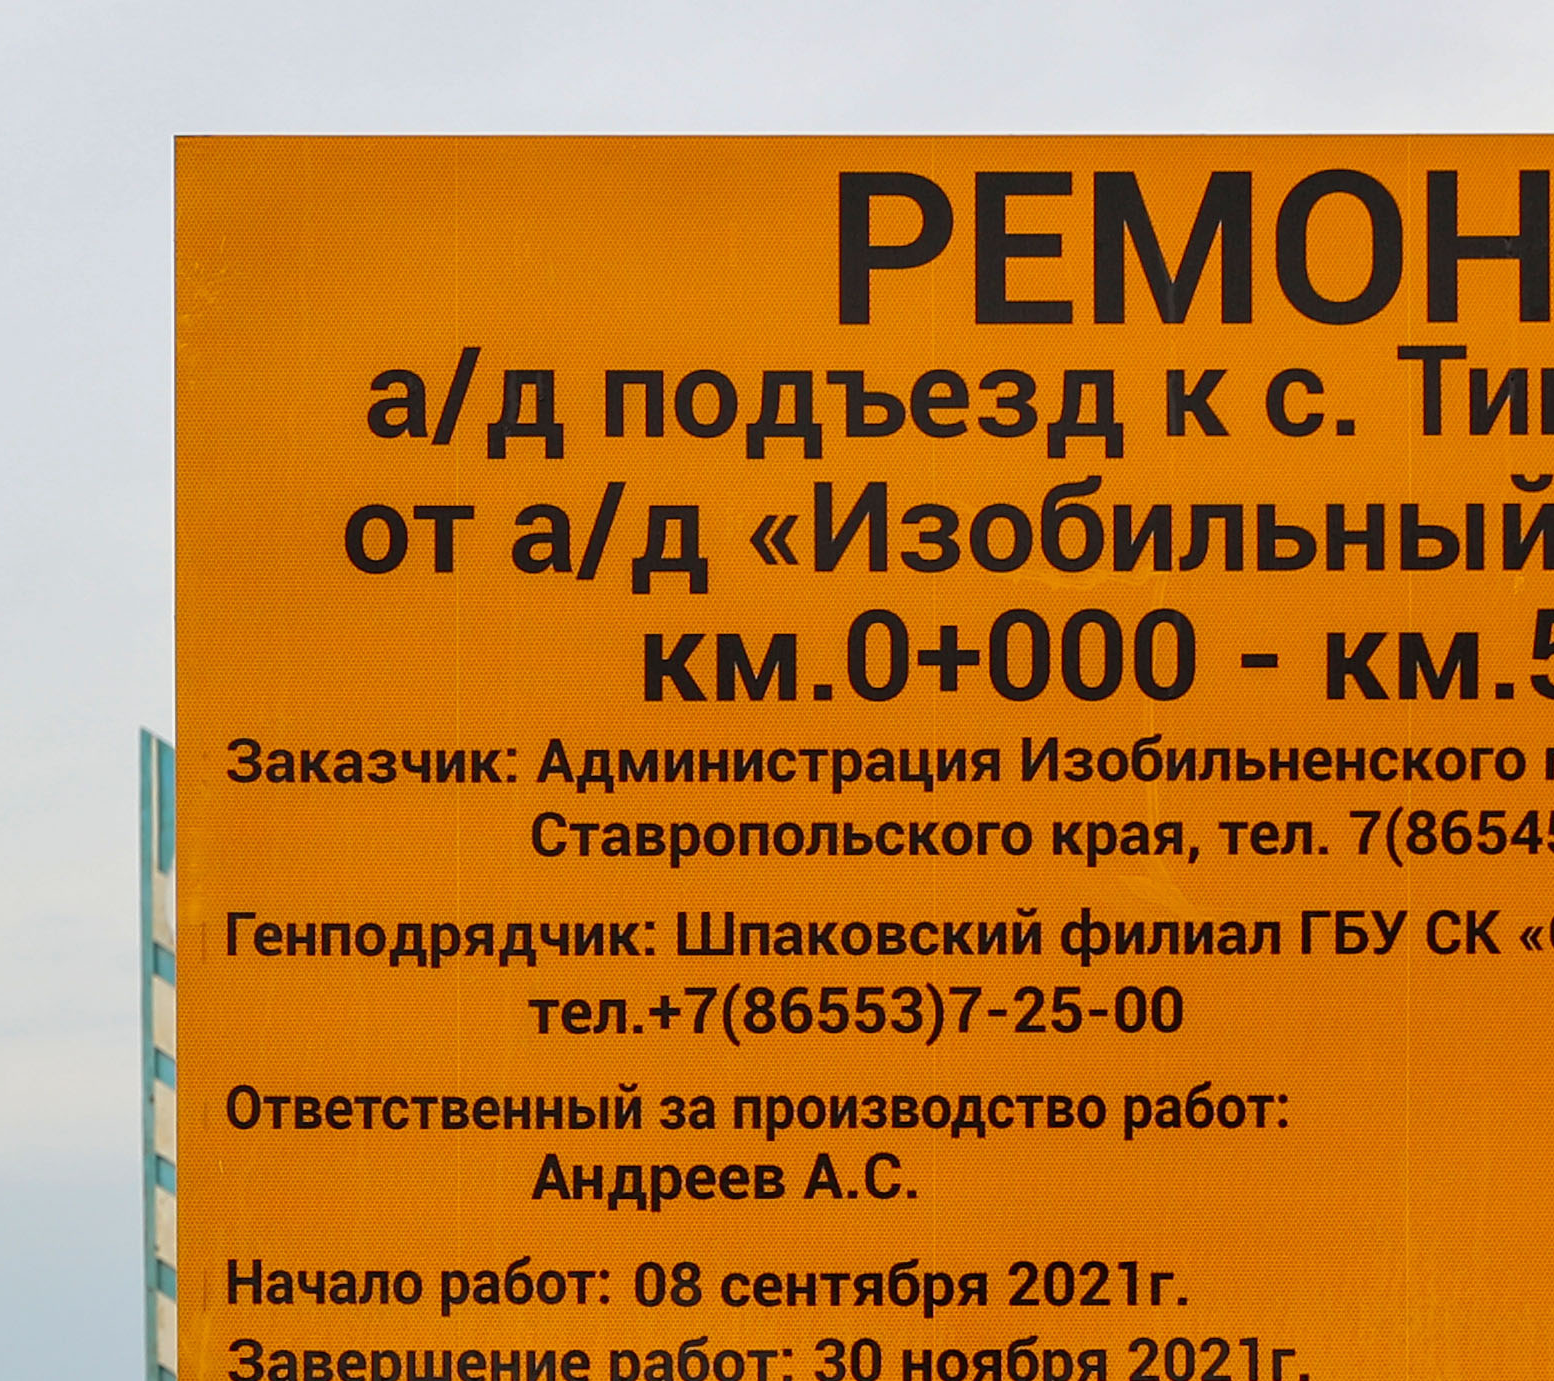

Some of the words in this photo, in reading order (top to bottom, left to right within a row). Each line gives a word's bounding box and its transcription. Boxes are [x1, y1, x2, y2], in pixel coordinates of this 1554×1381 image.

[367, 346, 564, 460] а/д
[605, 369, 1124, 460] подъезд
[1166, 369, 1229, 437] к
[1265, 367, 1355, 438] с.
[344, 503, 475, 575] от
[511, 481, 709, 595] а/д
[644, 608, 1196, 702] км.0+000
[1242, 654, 1278, 668] -
[227, 737, 517, 784] Заказчик:
[537, 738, 1000, 794] Администрация
[1021, 733, 1527, 782] Изобильненского
[531, 811, 1033, 869] Ставропольского
[1052, 821, 1200, 868] края,
[1218, 820, 1329, 856] тел.
[227, 911, 655, 969] Генподрядчик:
[677, 907, 1042, 956] Шпаковский
[1061, 907, 1281, 968] филиал
[1301, 910, 1408, 955] ГБУ
[1426, 909, 1501, 955] СК
[528, 983, 1184, 1047] тел.+7(86553)7-25-00
[226, 1083, 642, 1130] Ответственный
[660, 1095, 716, 1130] за
[734, 1094, 1107, 1142] производство
[1124, 1080, 1288, 1141] работ:
[531, 1153, 786, 1213] Андреев
[803, 1152, 917, 1200] А.С.
[227, 1258, 423, 1305] Начало
[441, 1255, 610, 1317] работ:
[635, 1261, 702, 1308] 08
[721, 1258, 988, 1319] сентября
[1008, 1260, 1188, 1307] 2021г.
